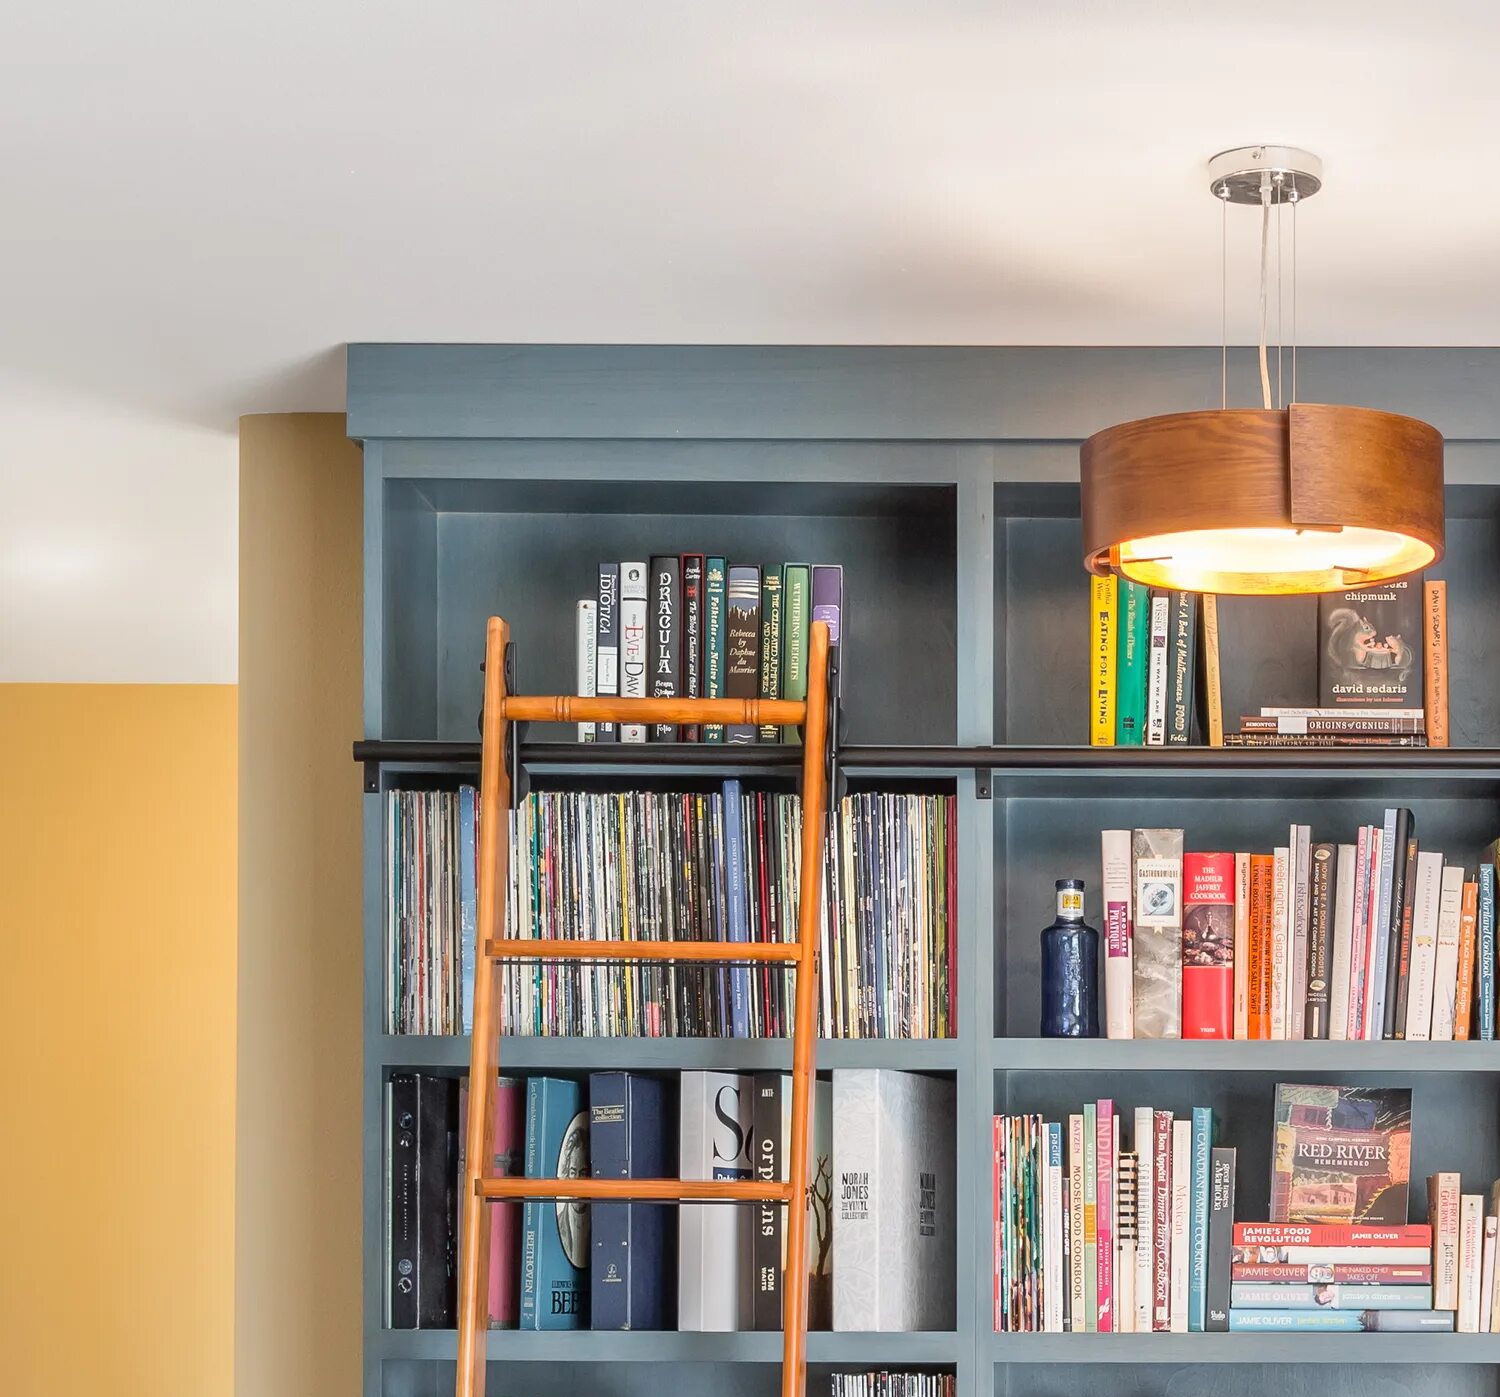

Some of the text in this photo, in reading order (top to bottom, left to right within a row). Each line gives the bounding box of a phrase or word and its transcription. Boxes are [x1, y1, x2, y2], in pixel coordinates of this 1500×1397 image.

[600, 573, 611, 634] IDIOTICA
[1345, 592, 1397, 602] chipmunk
[657, 572, 673, 674] DRACULA
[729, 629, 756, 638] Rebecca
[791, 583, 801, 681] WUTHERING HEIGHTS
[1099, 612, 1109, 651] EATING
[1178, 620, 1188, 637] Book
[729, 648, 756, 658] Daphne
[738, 638, 746, 647] by
[1177, 639, 1187, 647] of
[728, 667, 757, 675] Maurier
[737, 656, 747, 665] du
[625, 662, 643, 696] DAW
[1176, 648, 1187, 702] Mediterranean
[1332, 684, 1407, 694] david sedaris
[1099, 689, 1109, 724] LIVING
[1175, 704, 1185, 731] FOOD
[1309, 720, 1390, 731] ORIGINS of GENIUS
[1139, 868, 1178, 878] GASTRONOMIQUE
[1195, 884, 1221, 892] JAFFREY
[1109, 909, 1119, 950] PRATIQUE
[1481, 868, 1493, 978] Savor Portland Cookbook
[592, 1107, 625, 1115] The Beatles
[1050, 1133, 1060, 1165] pacific
[1097, 1117, 1111, 1182] INDIAN
[1158, 1133, 1167, 1151] Bon
[1298, 1143, 1386, 1160] RED RIVER
[1314, 1159, 1369, 1167] REMEMBERED
[842, 1173, 869, 1185] NORAH
[1214, 1167, 1224, 1210] Manitoba
[1222, 1163, 1230, 1208] great tastes
[841, 1186, 869, 1199] JONES
[1073, 1119, 1082, 1300] KATZEN MOOSEWOOD COOKBOOK
[1157, 1187, 1167, 1223] Dinner
[1175, 1184, 1187, 1235] Mexican
[1155, 1223, 1167, 1250] Party
[1243, 1228, 1282, 1236] JAMIE'S
[767, 1267, 775, 1291] TOM
[1156, 1250, 1167, 1300] Cookbook
